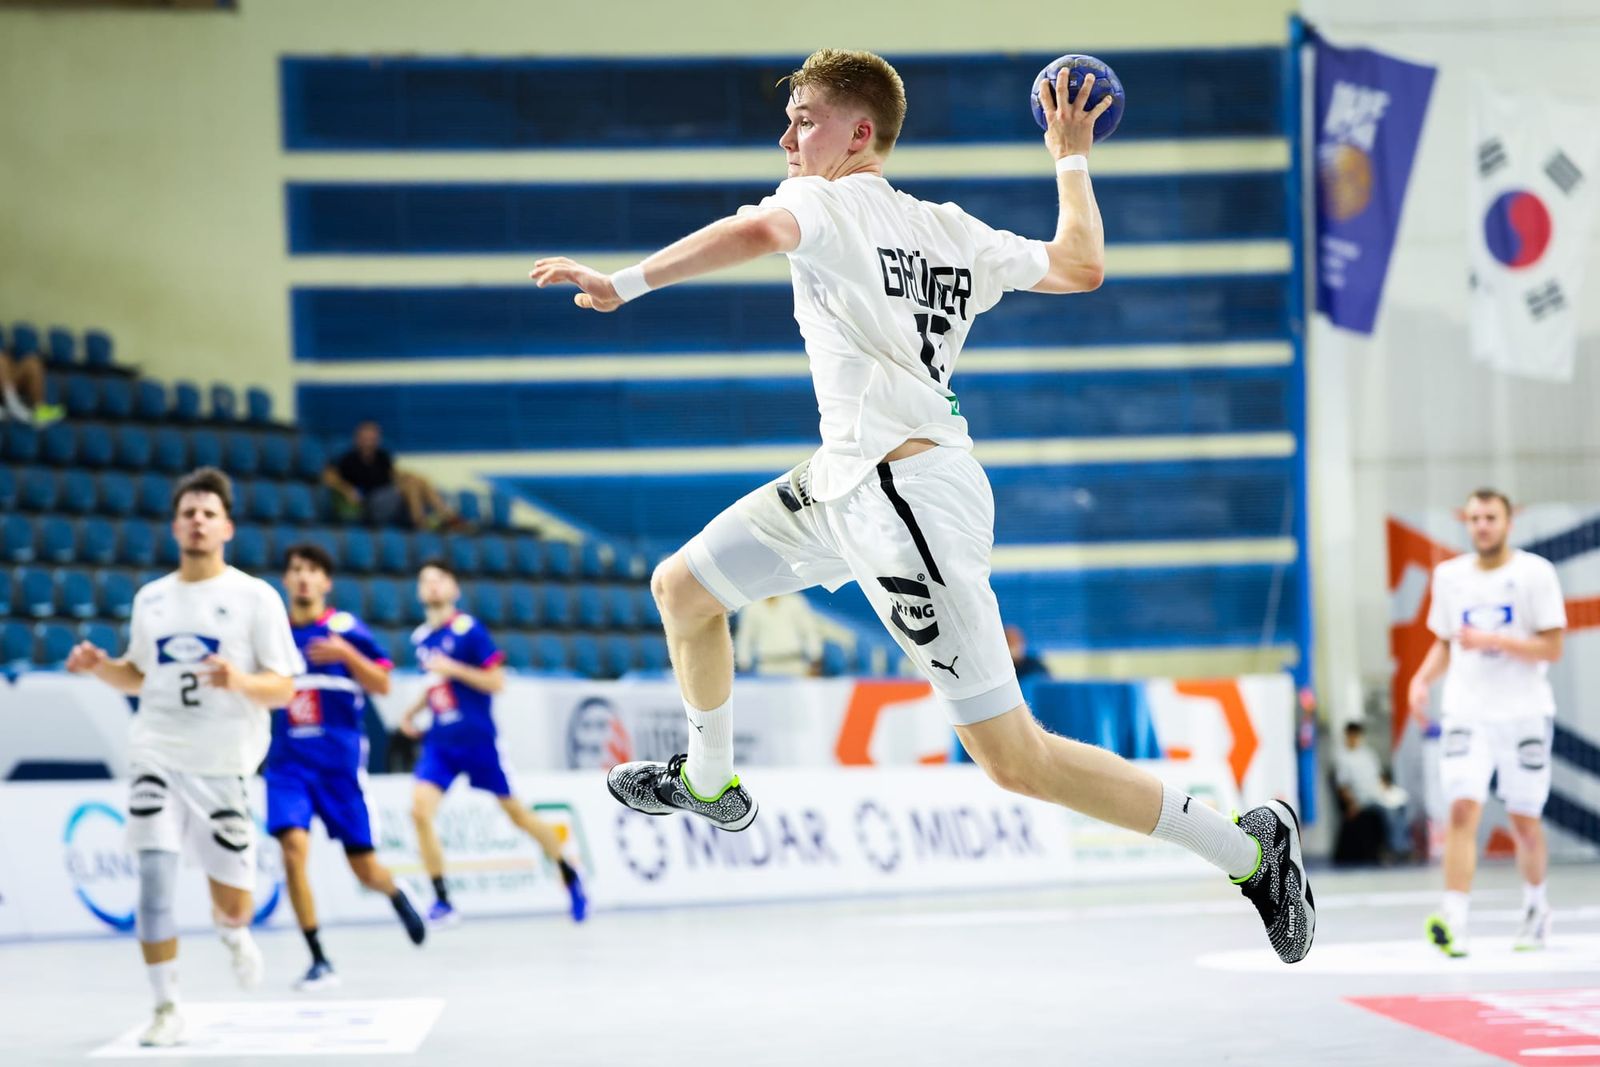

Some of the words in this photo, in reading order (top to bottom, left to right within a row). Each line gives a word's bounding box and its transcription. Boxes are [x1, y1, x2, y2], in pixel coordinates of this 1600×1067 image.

[180, 671, 201, 707] 2
[682, 807, 840, 867] MIDAR
[909, 804, 1047, 862] MIDAR
[1286, 905, 1297, 938] Kempa
